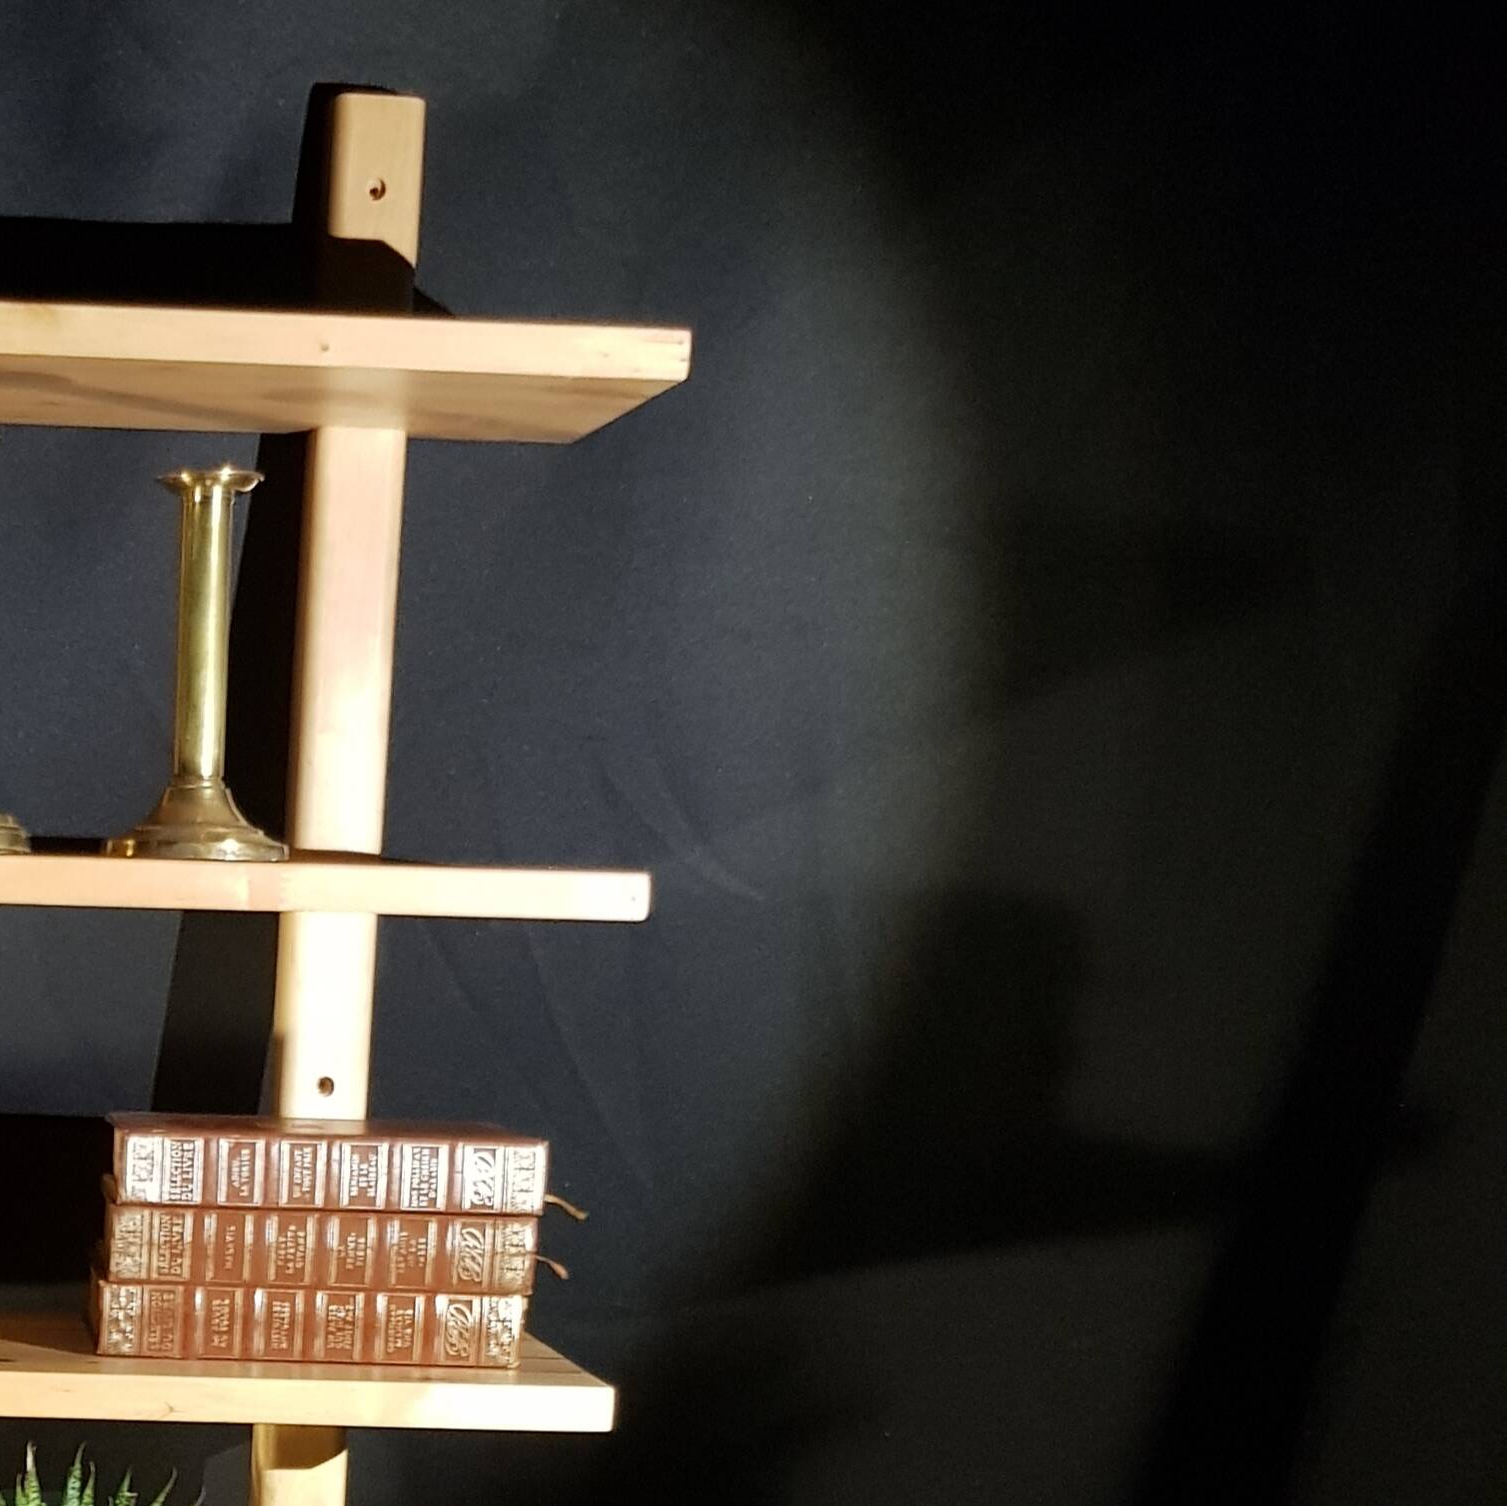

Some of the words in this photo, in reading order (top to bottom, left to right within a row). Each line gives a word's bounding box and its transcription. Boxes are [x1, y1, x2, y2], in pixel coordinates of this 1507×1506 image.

[182, 1142, 194, 1178] LIVRE
[181, 1183, 194, 1200] DU
[171, 1216, 184, 1253] LIVRE
[170, 1258, 183, 1274] DU
